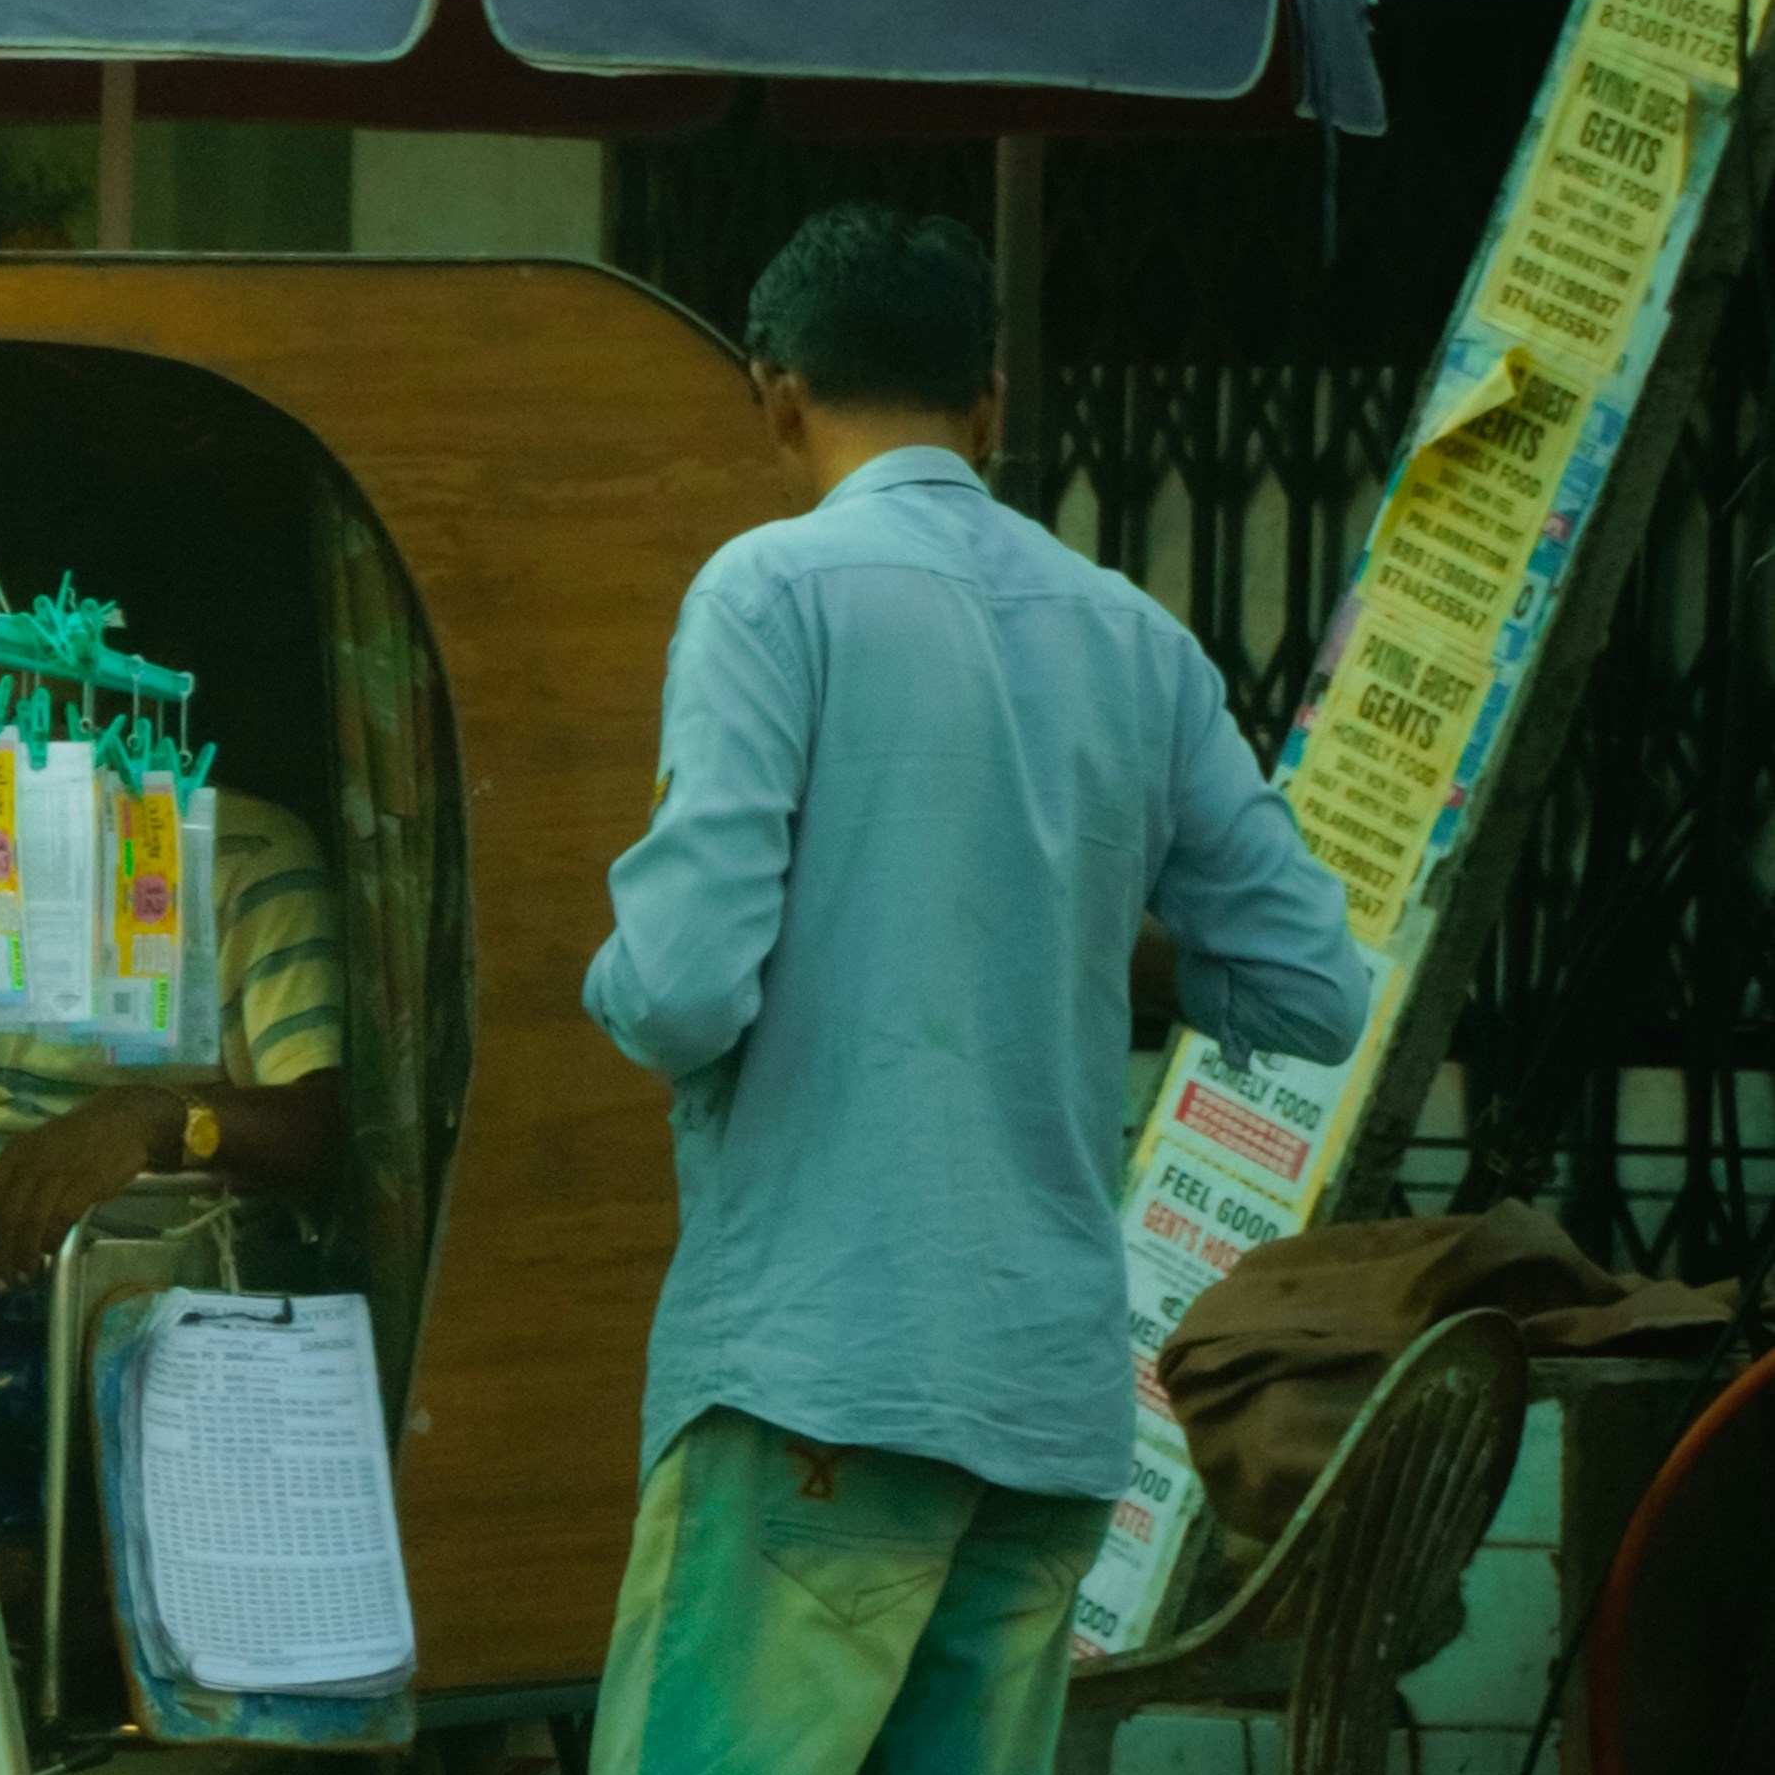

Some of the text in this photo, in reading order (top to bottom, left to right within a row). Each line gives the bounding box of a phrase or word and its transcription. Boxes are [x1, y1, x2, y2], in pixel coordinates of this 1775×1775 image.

[1599, 3, 1747, 70] 833081725
[1574, 59, 1643, 116] PAYING
[1582, 109, 1665, 176] GENTS
[1551, 151, 1664, 214] HOMELY FOOD
[1519, 374, 1580, 424] GUEST
[1498, 461, 1544, 500] FOOD
[1356, 632, 1477, 714] PAYING GUEST
[1357, 681, 1444, 752] GENTS
[1328, 718, 1441, 789] HOMELY FOOD
[1198, 1053, 1274, 1104] HOMELY
[1270, 1086, 1324, 1132] FOOD
[1156, 1163, 1279, 1241] FEEL GOOD
